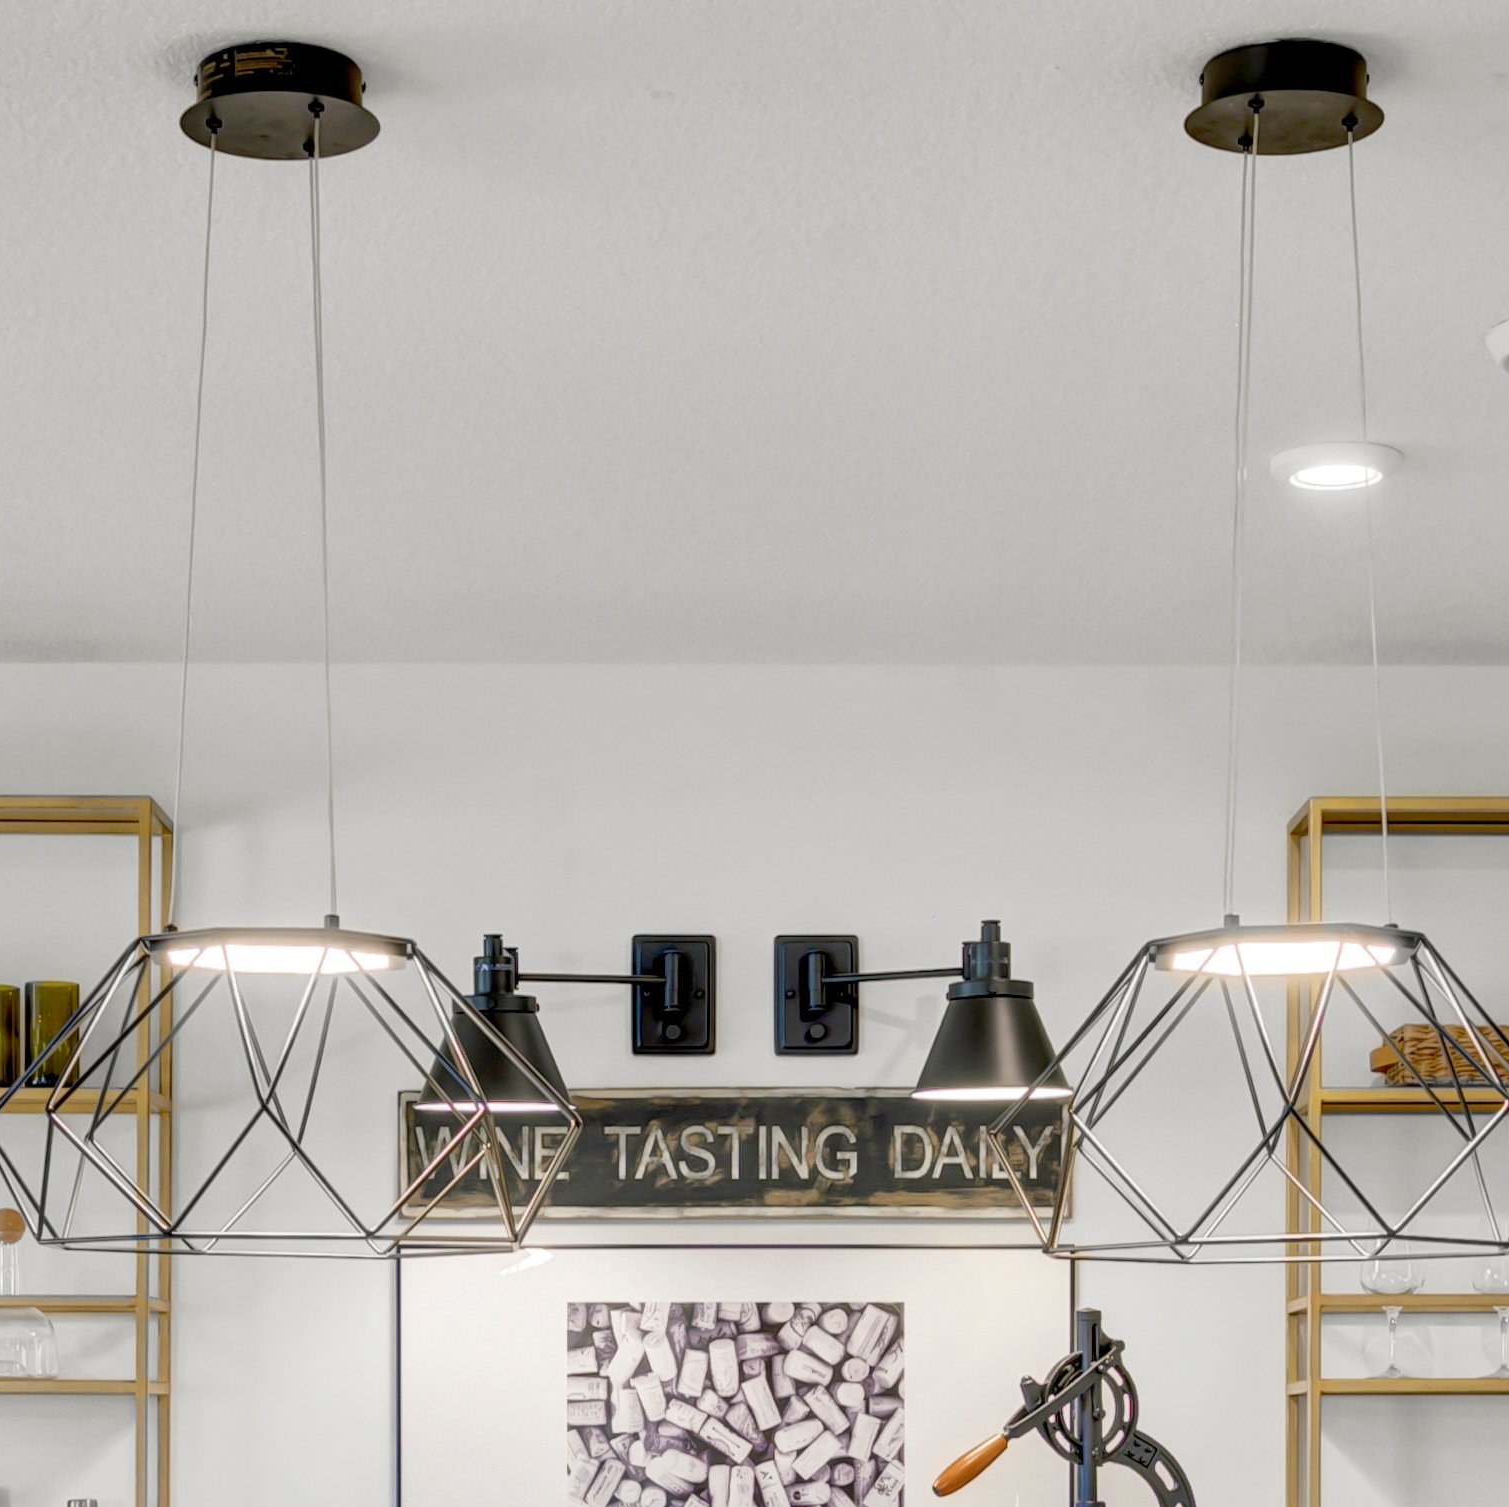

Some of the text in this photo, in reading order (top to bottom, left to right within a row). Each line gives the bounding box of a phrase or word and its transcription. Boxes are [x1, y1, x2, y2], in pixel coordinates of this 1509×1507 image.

[414, 1125, 1054, 1181] WINE TASTING DAILY
